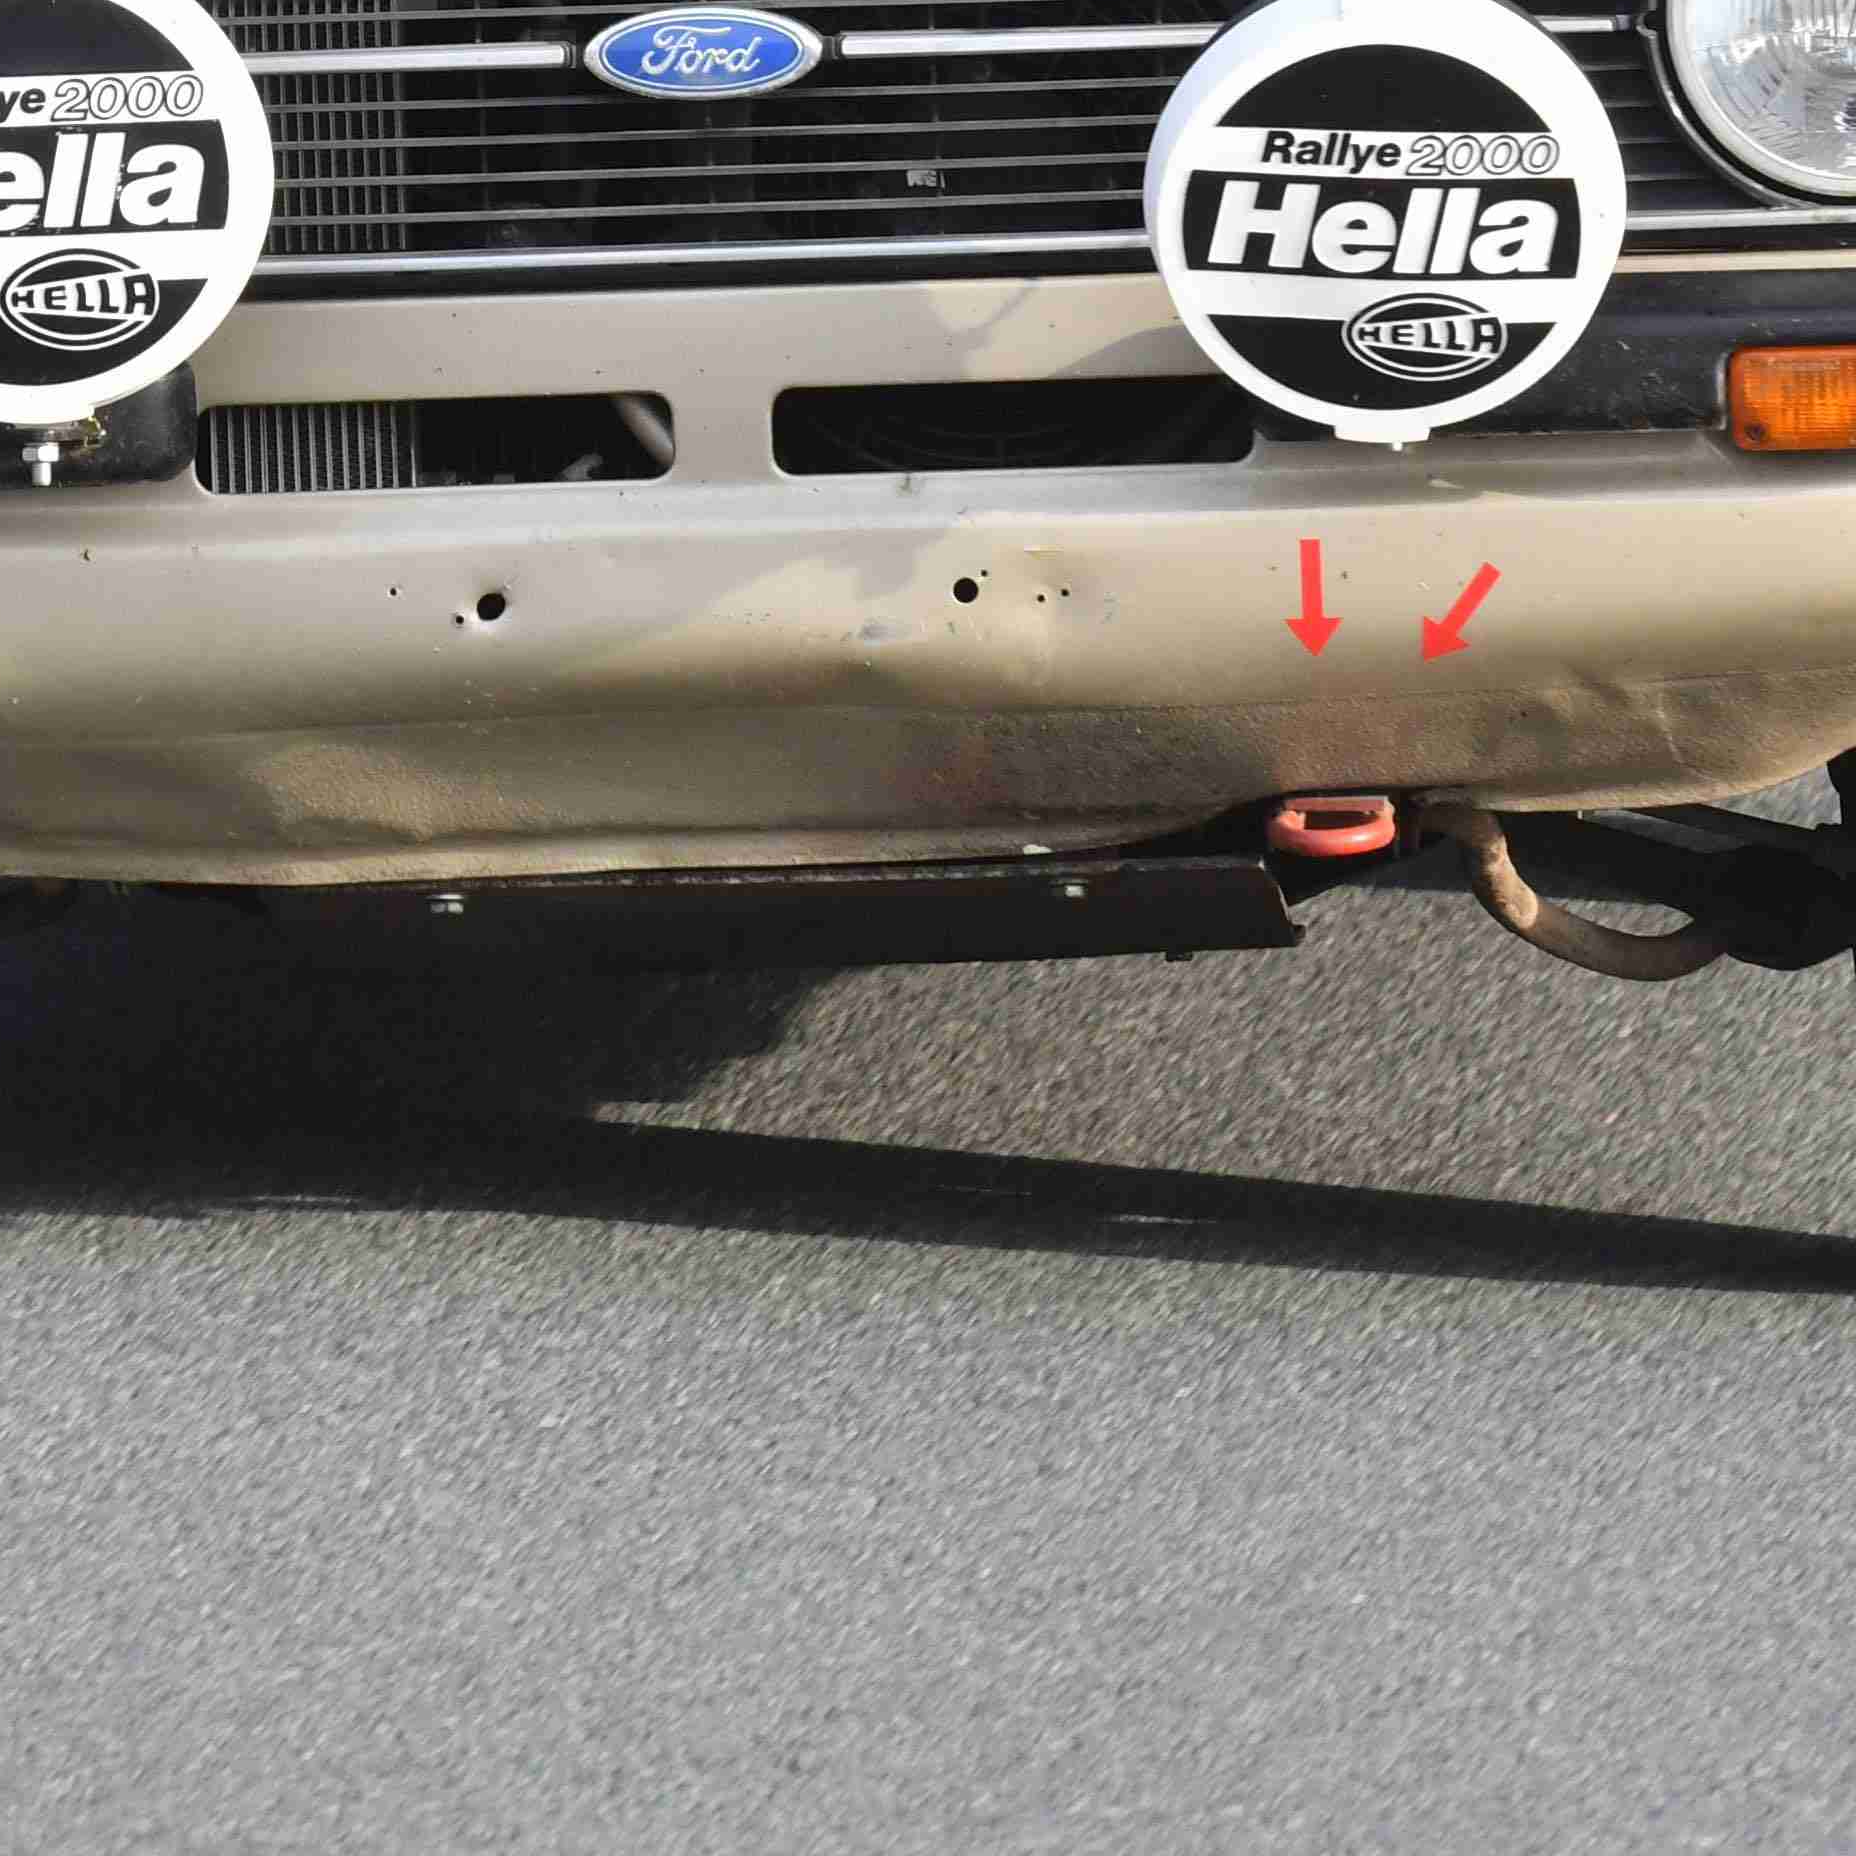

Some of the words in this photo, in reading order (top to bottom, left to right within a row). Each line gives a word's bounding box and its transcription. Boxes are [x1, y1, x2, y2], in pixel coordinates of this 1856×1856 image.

[641, 24, 763, 75] Ford
[51, 74, 204, 121] 2000
[1260, 130, 1401, 175] Rallye
[1406, 135, 1560, 177] 2000
[1207, 179, 1559, 275] Hella
[10, 273, 157, 316] HELLA
[1357, 316, 1502, 355] HELLA
